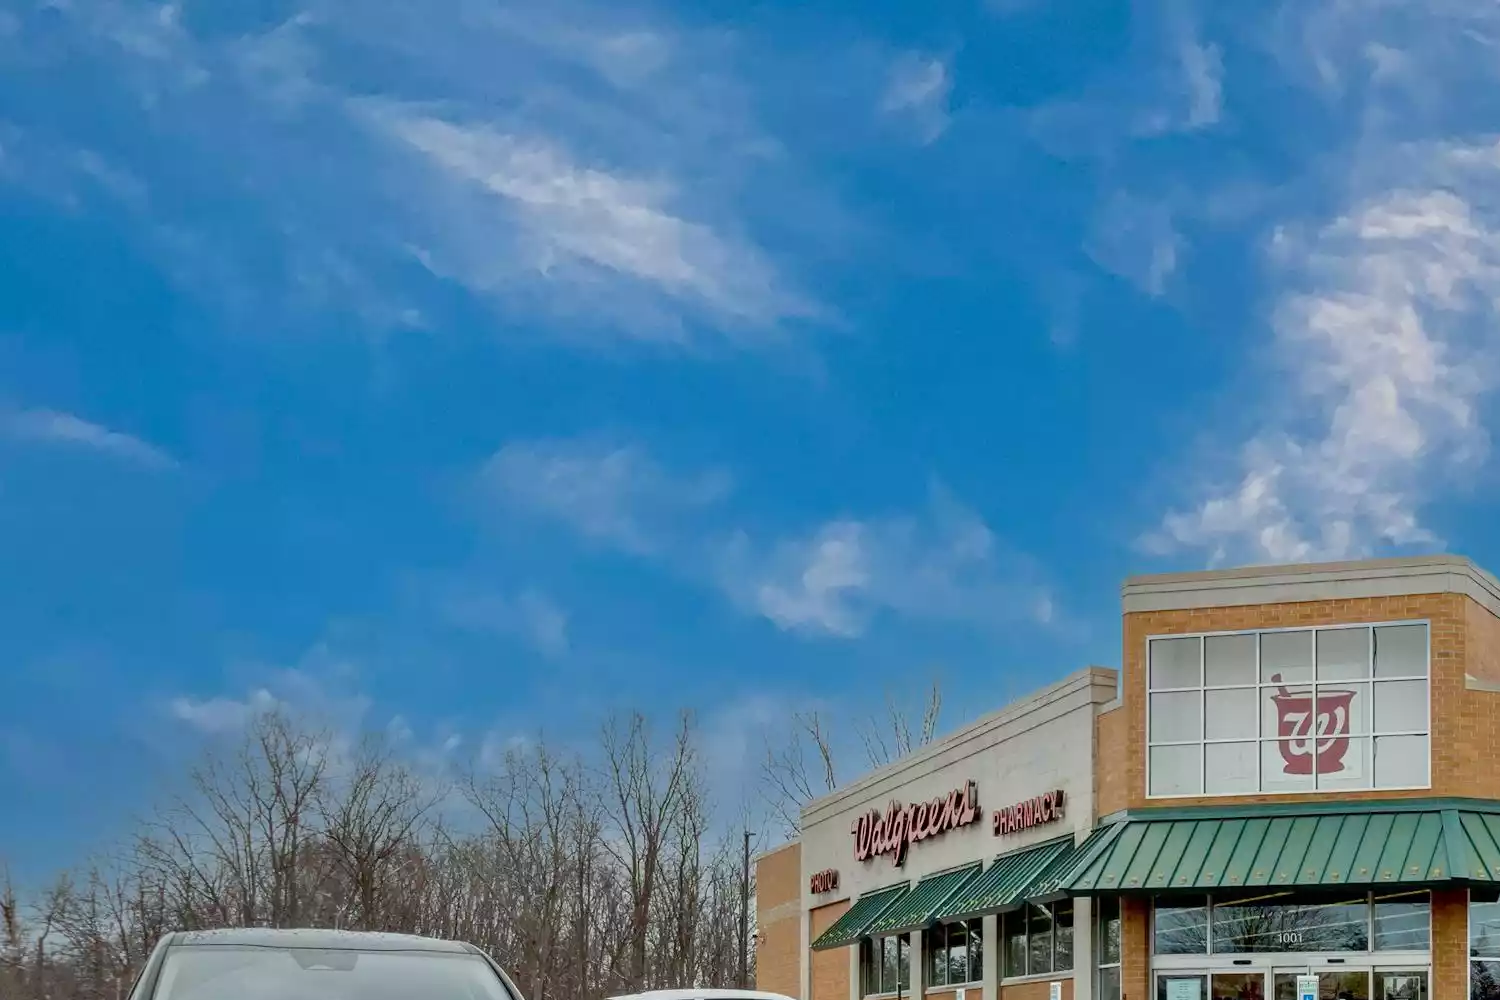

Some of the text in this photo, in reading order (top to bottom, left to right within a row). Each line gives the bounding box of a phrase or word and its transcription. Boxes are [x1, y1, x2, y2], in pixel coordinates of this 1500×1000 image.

[1283, 706, 1346, 756] W
[851, 779, 980, 867] Walgreens
[992, 790, 1065, 836] PHARMACY
[811, 868, 838, 894] PHOTO
[1278, 932, 1303, 944] 1001
